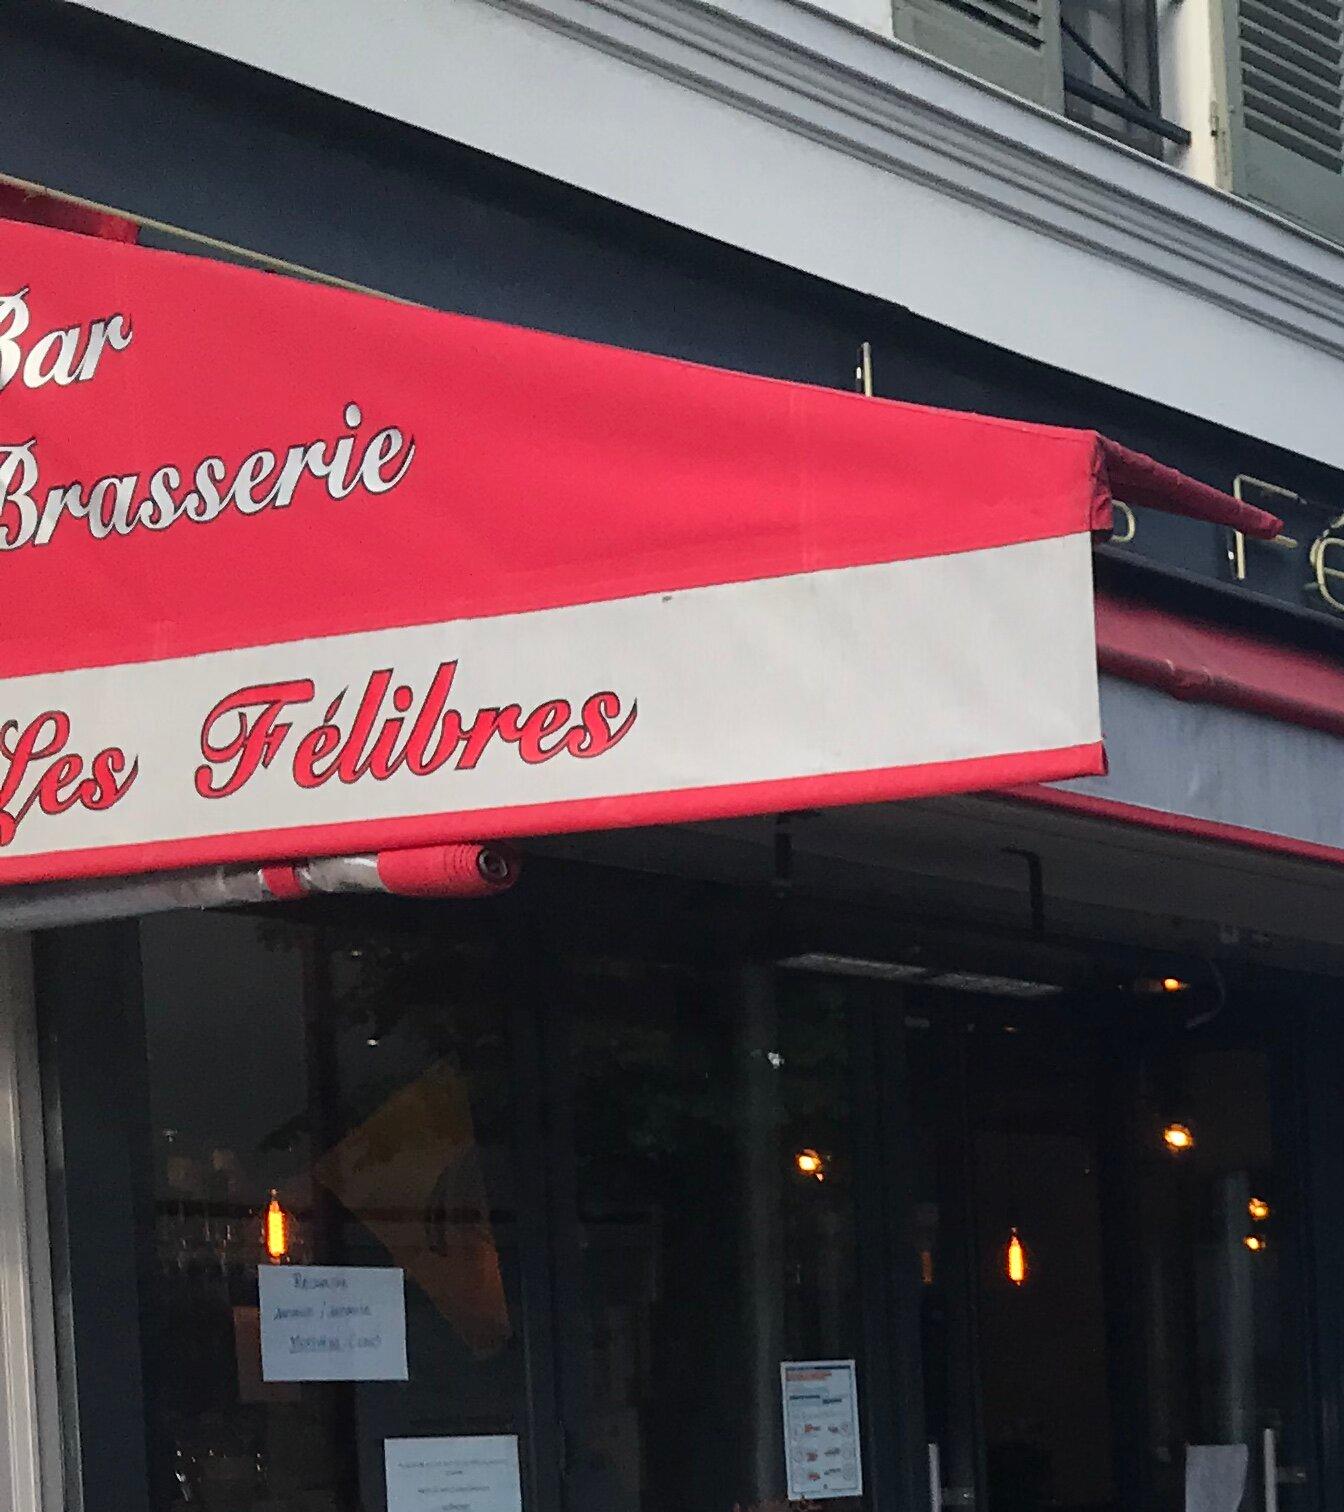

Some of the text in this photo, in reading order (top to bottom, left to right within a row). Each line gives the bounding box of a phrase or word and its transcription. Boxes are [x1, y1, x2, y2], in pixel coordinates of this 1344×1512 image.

[0, 285, 133, 391] Bar
[0, 401, 416, 551] Brasserie
[0, 658, 639, 847] Les Félibres
